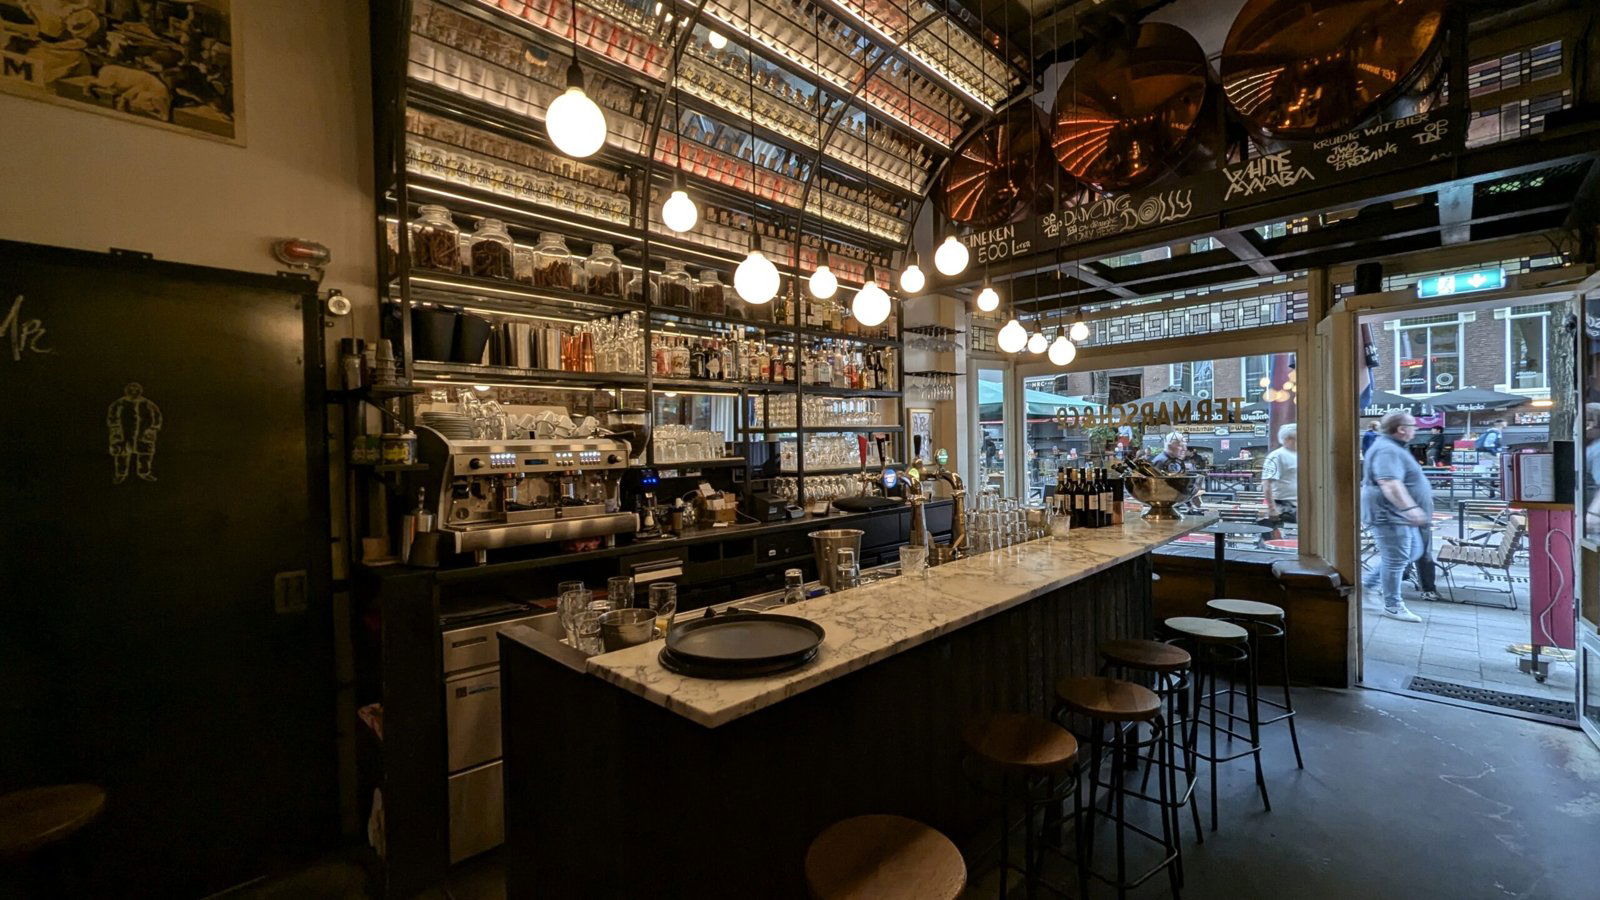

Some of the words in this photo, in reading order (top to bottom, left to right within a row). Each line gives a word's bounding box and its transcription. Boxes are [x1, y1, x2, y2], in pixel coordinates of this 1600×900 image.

[1313, 131, 1361, 151] KRUIDIG
[1363, 121, 1395, 137] WIT
[1394, 113, 1430, 129] BIER
[1222, 150, 1292, 183] WHITE
[1223, 166, 1316, 202] MAMBA
[1119, 189, 1193, 232] DOLLY
[978, 241, 1009, 264] 500
